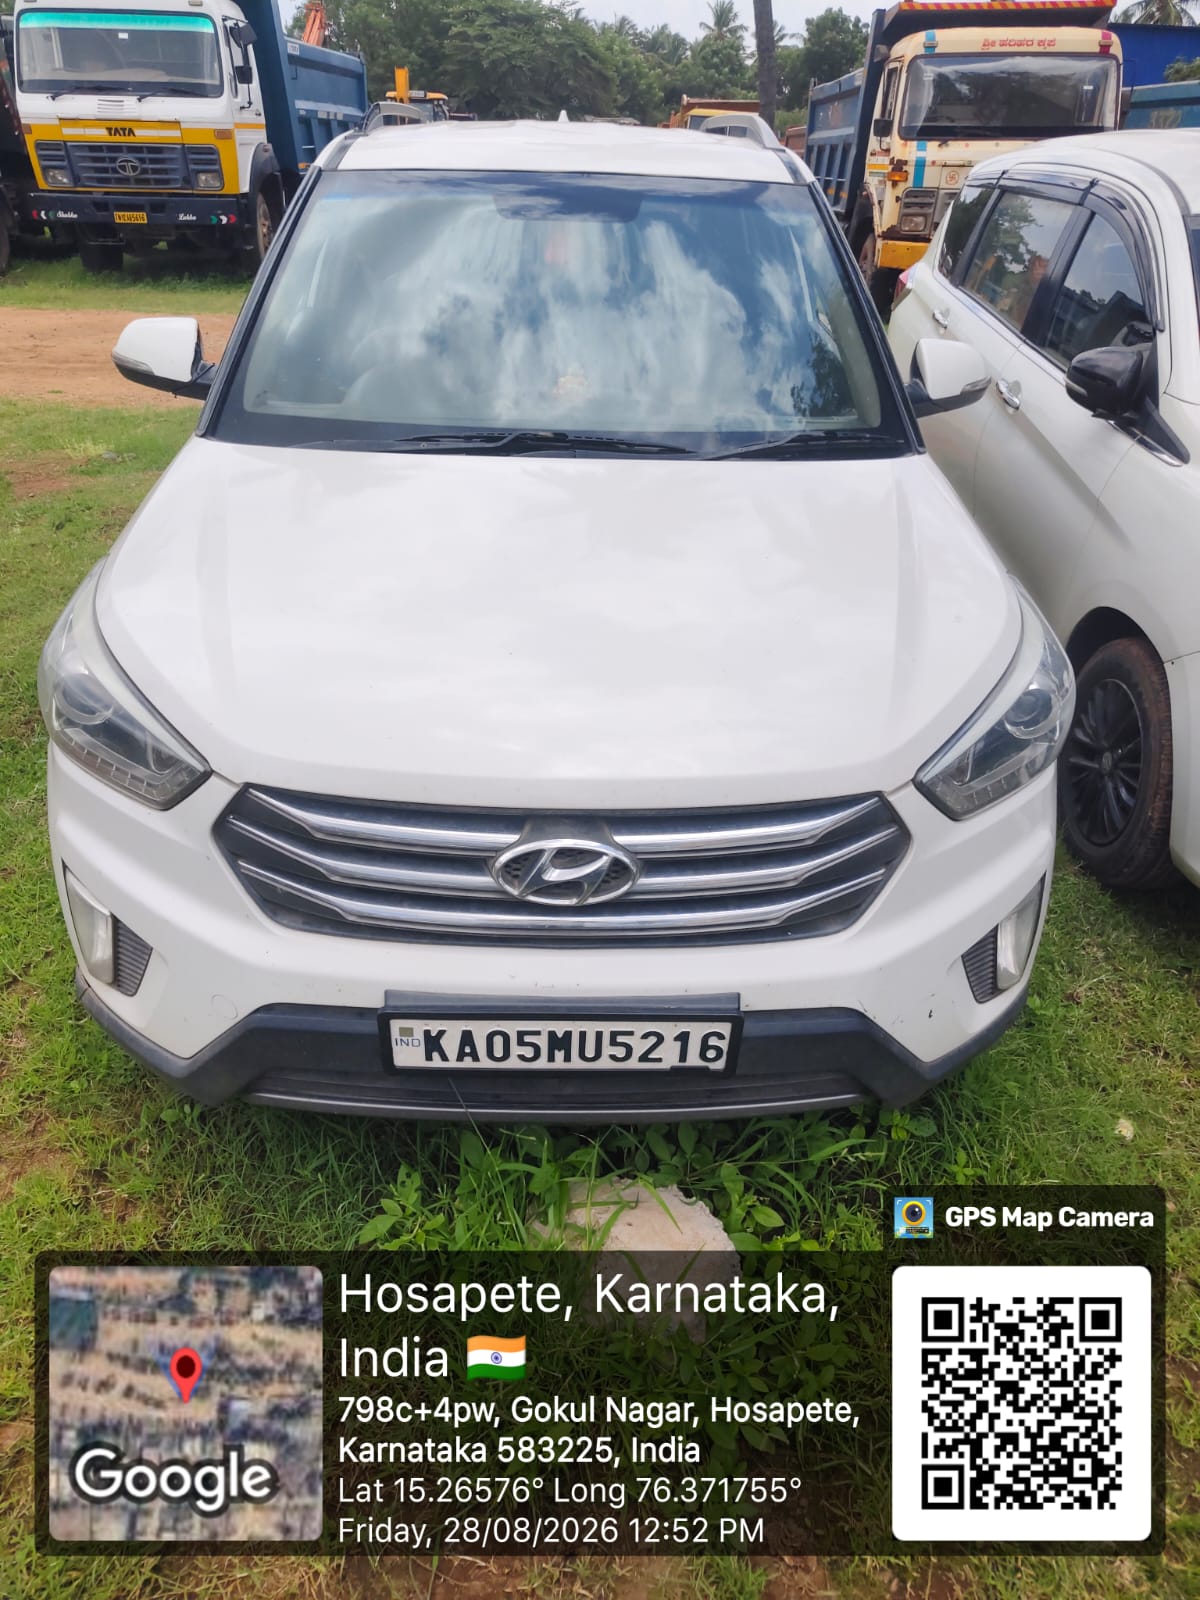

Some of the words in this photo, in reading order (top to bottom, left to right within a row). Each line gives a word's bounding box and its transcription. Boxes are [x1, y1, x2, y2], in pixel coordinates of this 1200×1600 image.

[105, 127, 136, 137] TATA
[394, 1036, 421, 1048] IND
[423, 1029, 726, 1063] KA05MU5216
